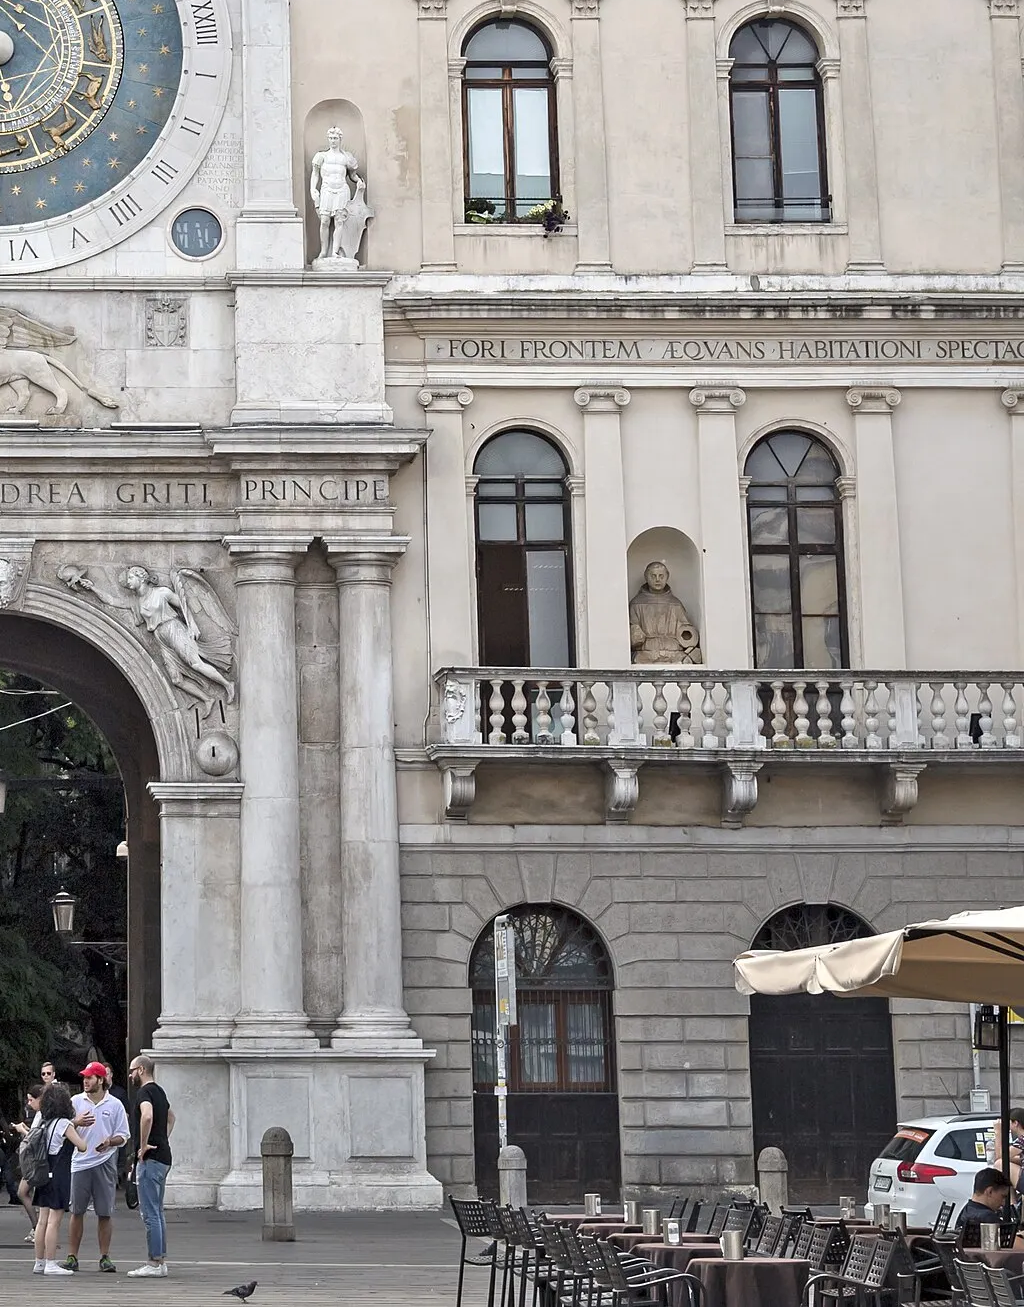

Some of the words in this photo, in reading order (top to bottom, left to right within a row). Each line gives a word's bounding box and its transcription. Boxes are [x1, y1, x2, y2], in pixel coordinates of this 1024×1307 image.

[191, 0, 218, 45] XXIIII
[66, 45, 77, 79] MARTIVS
[43, 84, 67, 111] APRILIS
[151, 159, 178, 185] III
[108, 194, 142, 226] IIII
[71, 226, 90, 249] V
[176, 220, 217, 248] MAG
[9, 239, 38, 261] VI
[449, 339, 507, 358] FORI
[520, 340, 642, 359] FRONTEM
[778, 340, 923, 359] HABITATIONI
[117, 481, 212, 505] GRITI
[244, 478, 388, 503] PRINCIPE
